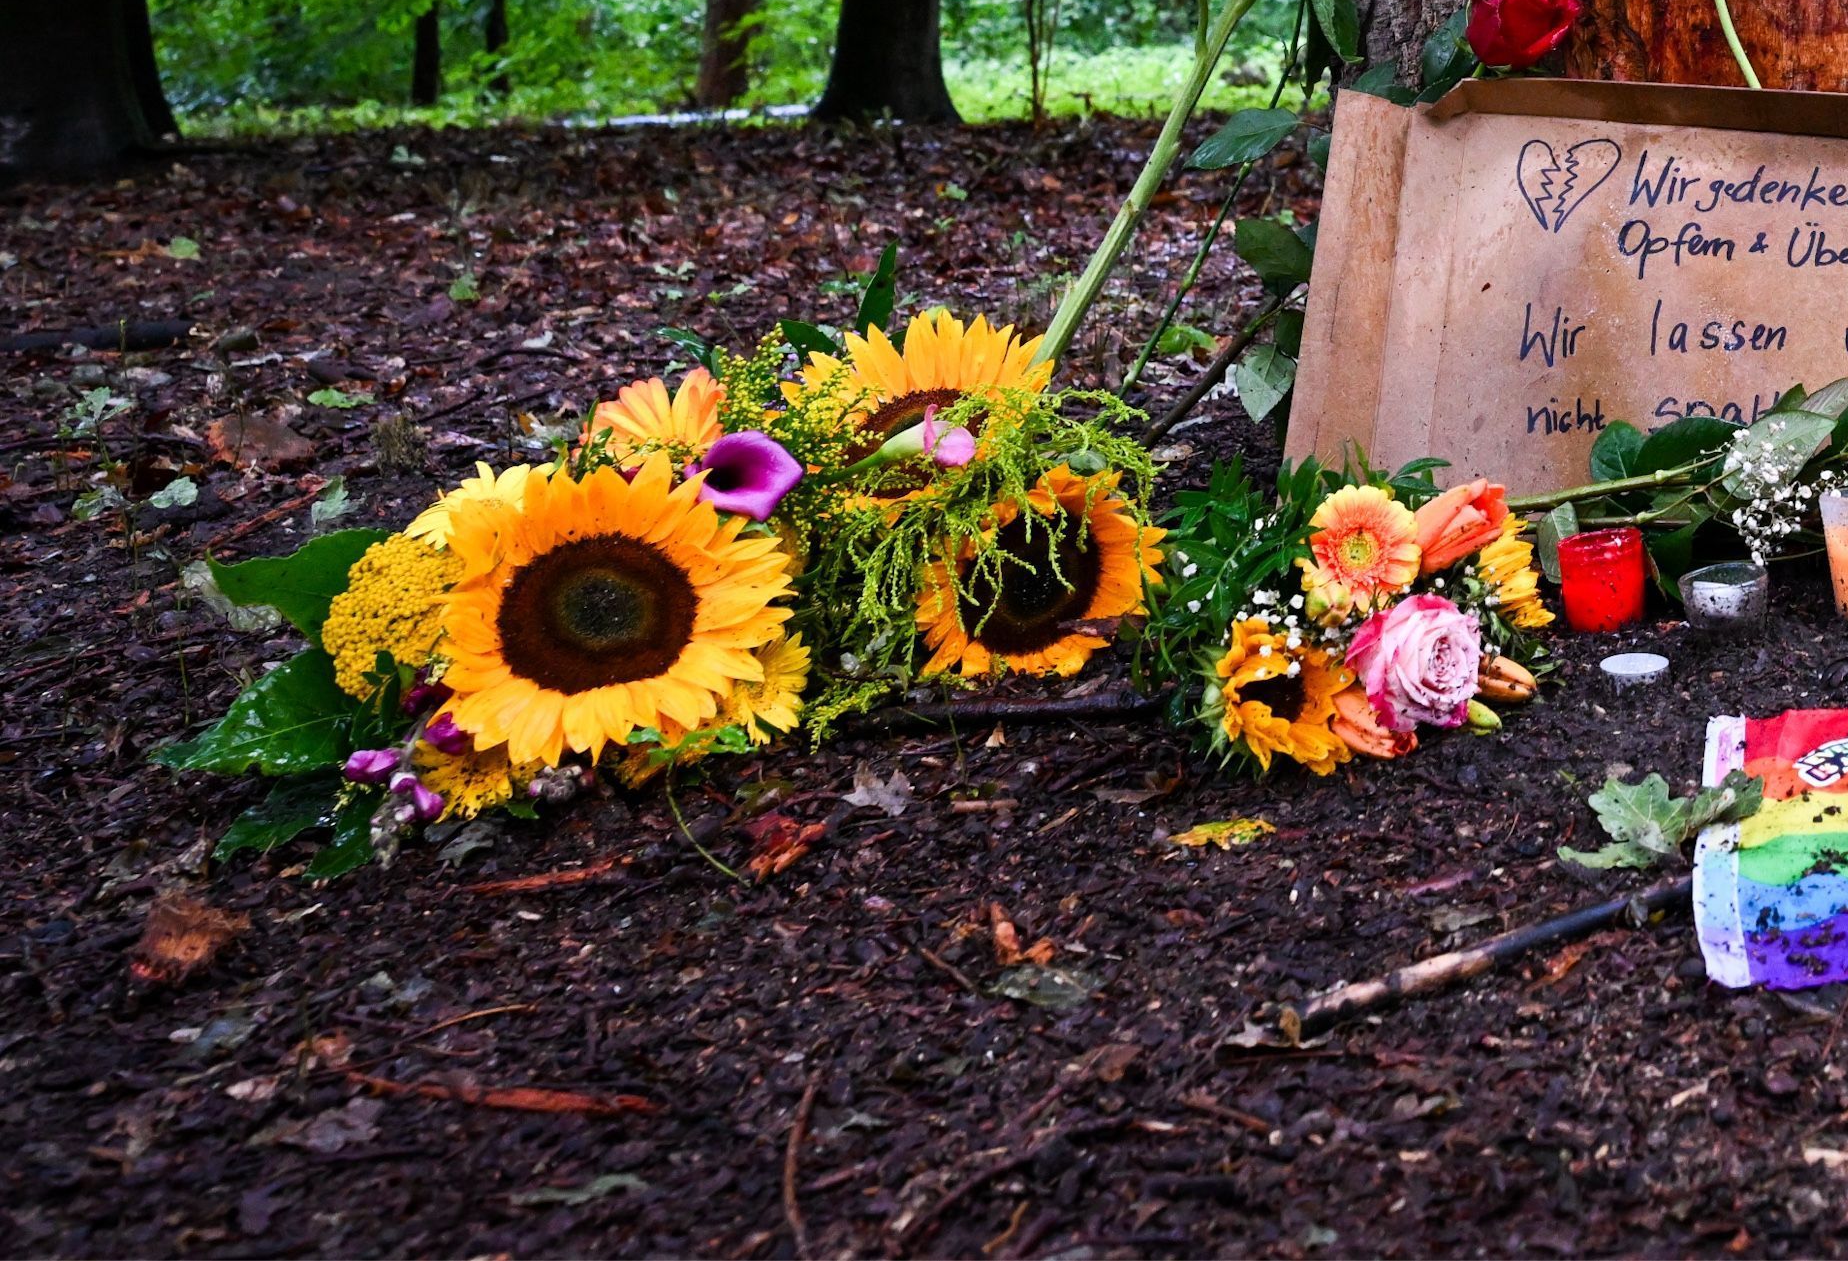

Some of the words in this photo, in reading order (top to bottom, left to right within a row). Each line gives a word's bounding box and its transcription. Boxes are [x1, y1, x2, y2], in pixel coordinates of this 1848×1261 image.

[1629, 149, 1700, 207] Wir
[1617, 219, 1735, 280] Opfern
[1749, 231, 1769, 253] &
[1519, 302, 1586, 368] Wir
[1650, 299, 1787, 356] lassen
[1527, 398, 1606, 434] nicht
